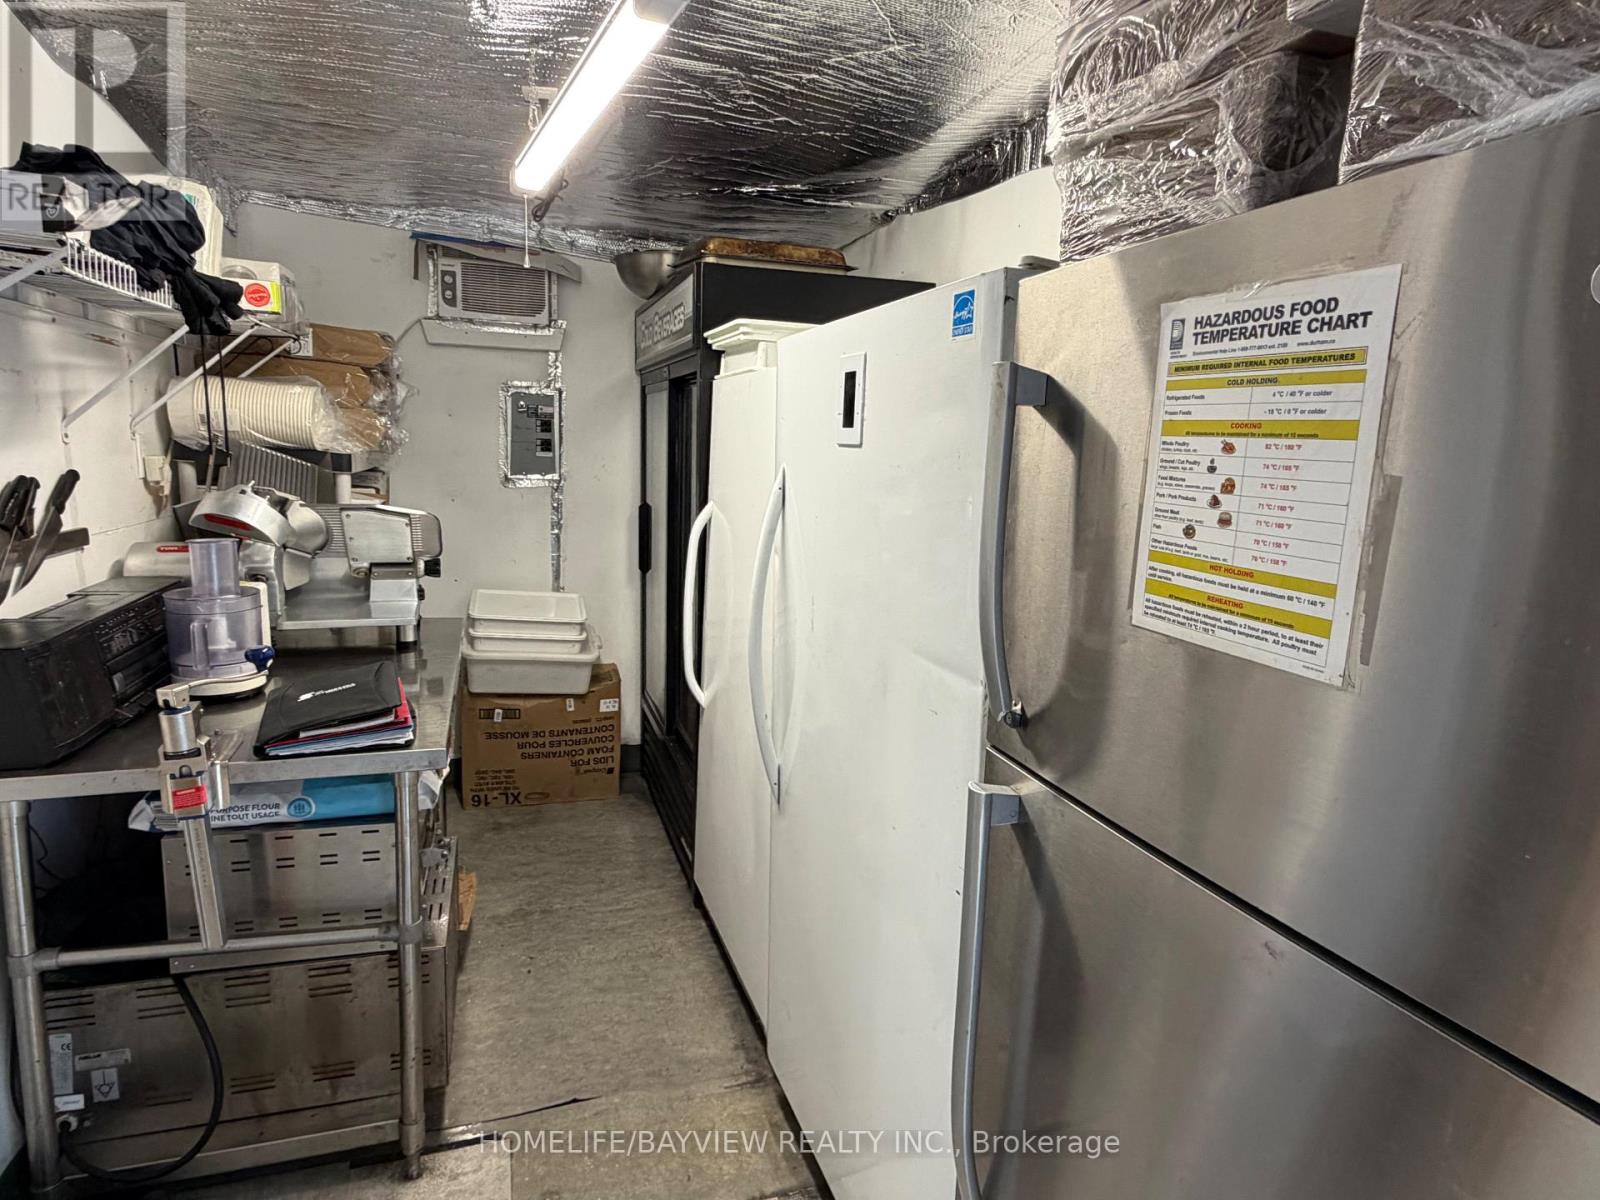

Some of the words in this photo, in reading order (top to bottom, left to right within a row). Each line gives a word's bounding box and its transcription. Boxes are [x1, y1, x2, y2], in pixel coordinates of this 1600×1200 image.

[1194, 304, 1285, 330] HAZARDOUS
[1290, 297, 1339, 316] FOOD
[1193, 320, 1302, 345] TEMPERATURE
[1307, 311, 1372, 333] CHART
[1234, 360, 1267, 368] INTERNAL
[1292, 353, 1355, 364] TEMPERATURES
[1224, 568, 1254, 578] HOLDING
[1260, 590, 1286, 600] minimum
[1207, 595, 1244, 609] REHEATING
[1217, 625, 1236, 635] cooking
[1237, 630, 1269, 643] temperature.
[1280, 642, 1300, 652] poultry
[1302, 647, 1317, 656] must
[1261, 628, 1280, 638] period,
[1310, 640, 1324, 649] their
[484, 731, 529, 740] MOUSSE
[549, 725, 615, 737] CONTENANTS
[549, 735, 615, 748] COUVERCLES
[521, 749, 584, 759] CONTAINERS
[587, 745, 614, 755] FOAM
[570, 759, 591, 767] FOR
[593, 756, 614, 764] LIDS
[472, 792, 522, 807] XL-16
[252, 802, 280, 811] FLOUR
